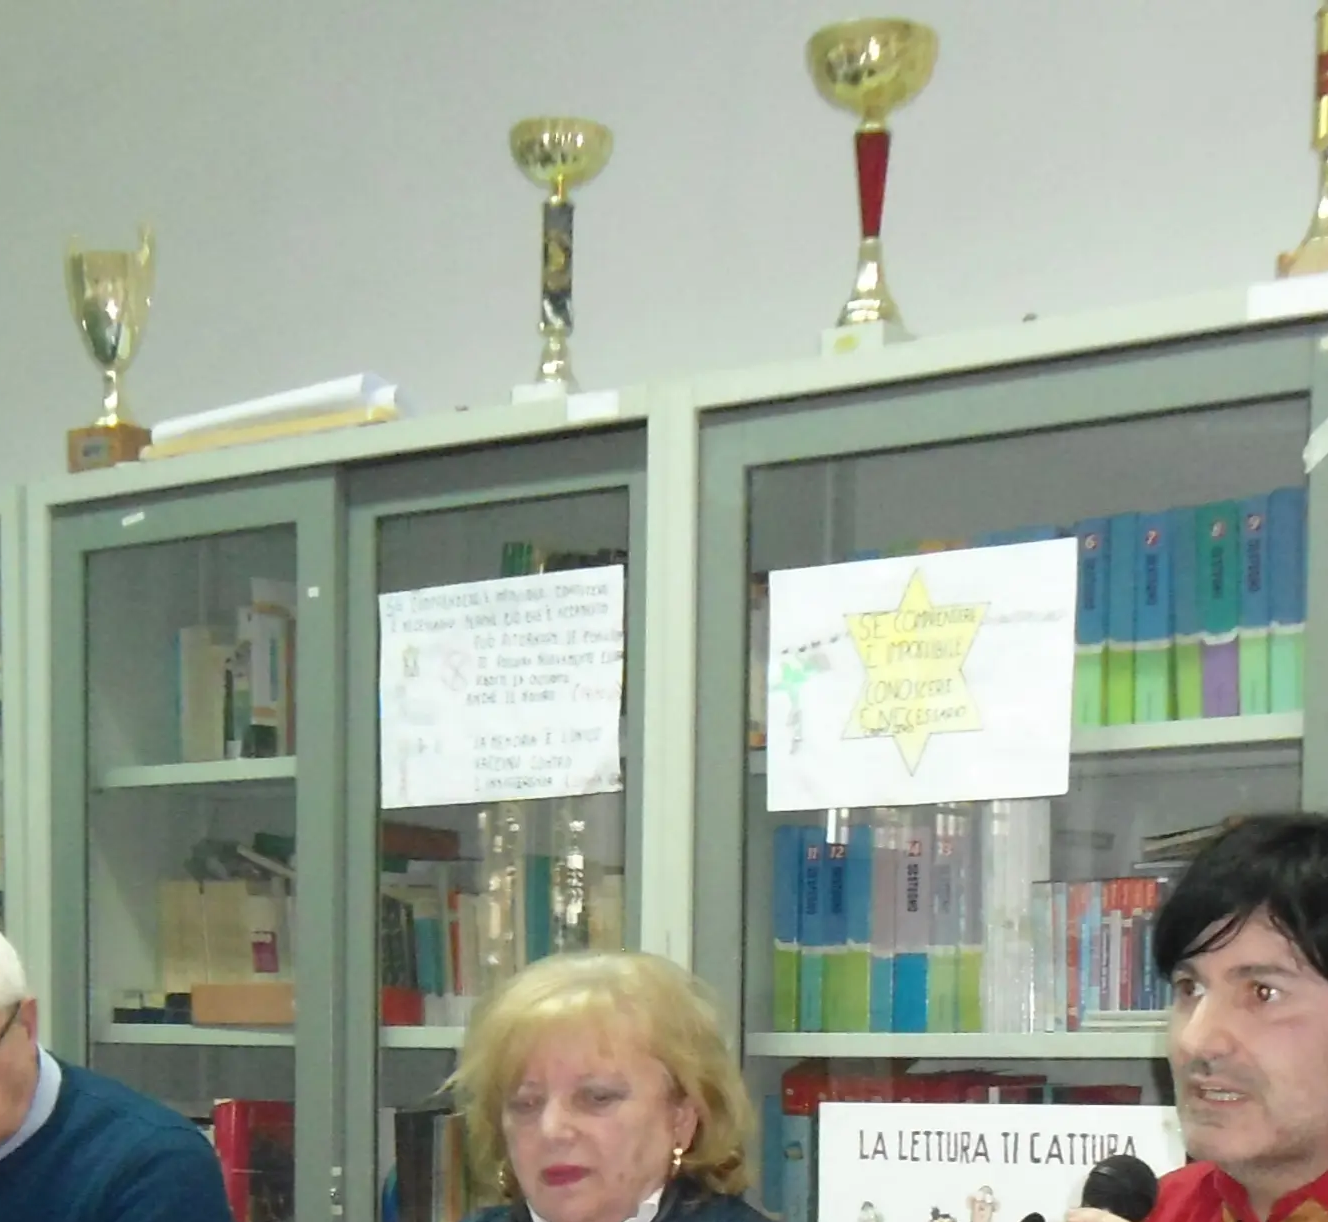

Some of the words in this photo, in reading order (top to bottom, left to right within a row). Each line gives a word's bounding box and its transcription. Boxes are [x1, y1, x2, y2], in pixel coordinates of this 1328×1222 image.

[859, 613, 888, 641] SE
[858, 1129, 889, 1161] LA
[897, 1129, 991, 1165] LETTURA
[1000, 1131, 1020, 1165] TI
[1028, 1131, 1139, 1167] CATTURA
